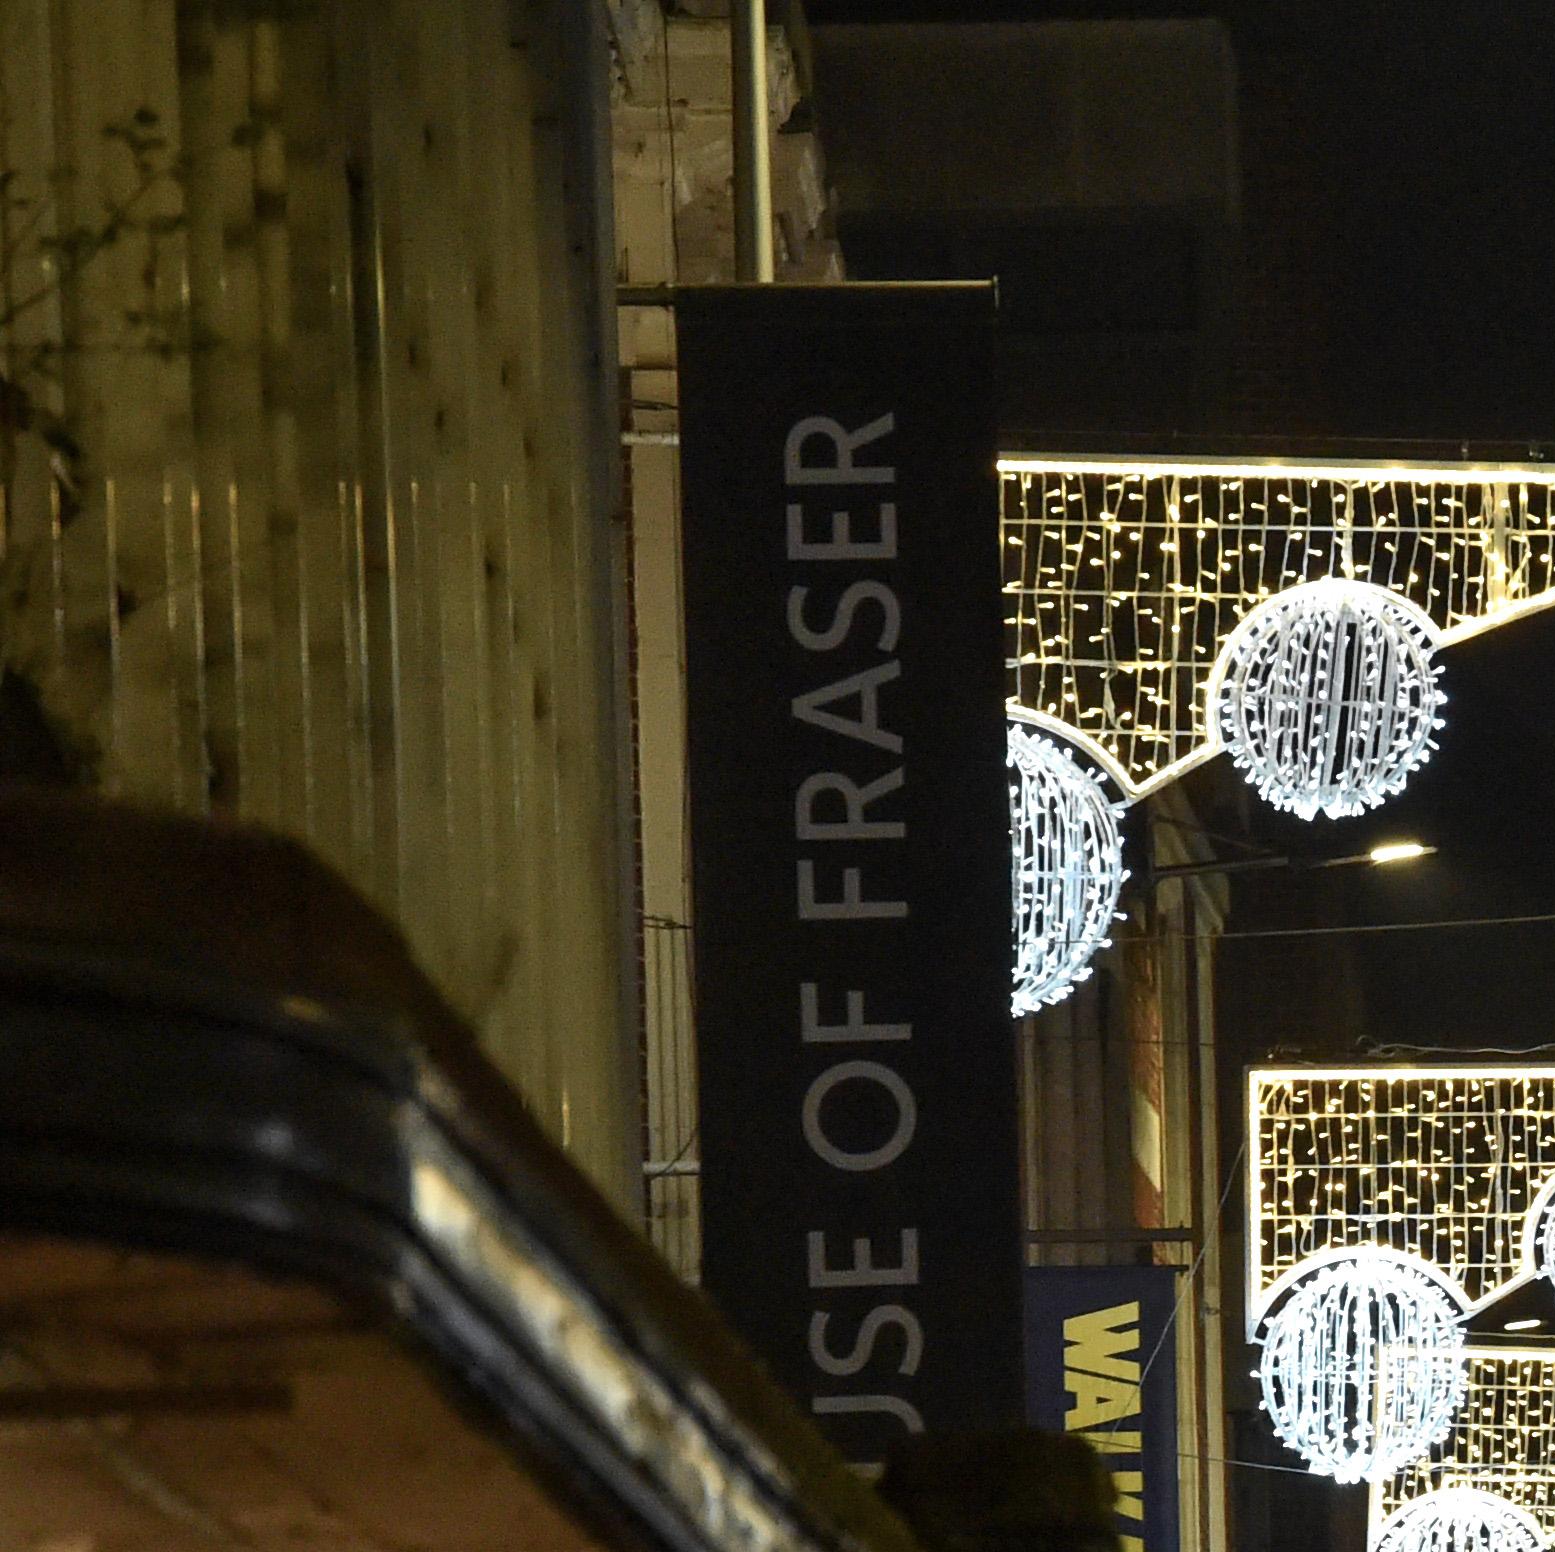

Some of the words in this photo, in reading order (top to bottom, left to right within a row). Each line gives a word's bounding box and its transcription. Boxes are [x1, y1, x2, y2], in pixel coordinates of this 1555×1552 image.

[784, 411, 909, 923] FRASER
[800, 979, 918, 1174] OF
[807, 1227, 926, 1480] USE
